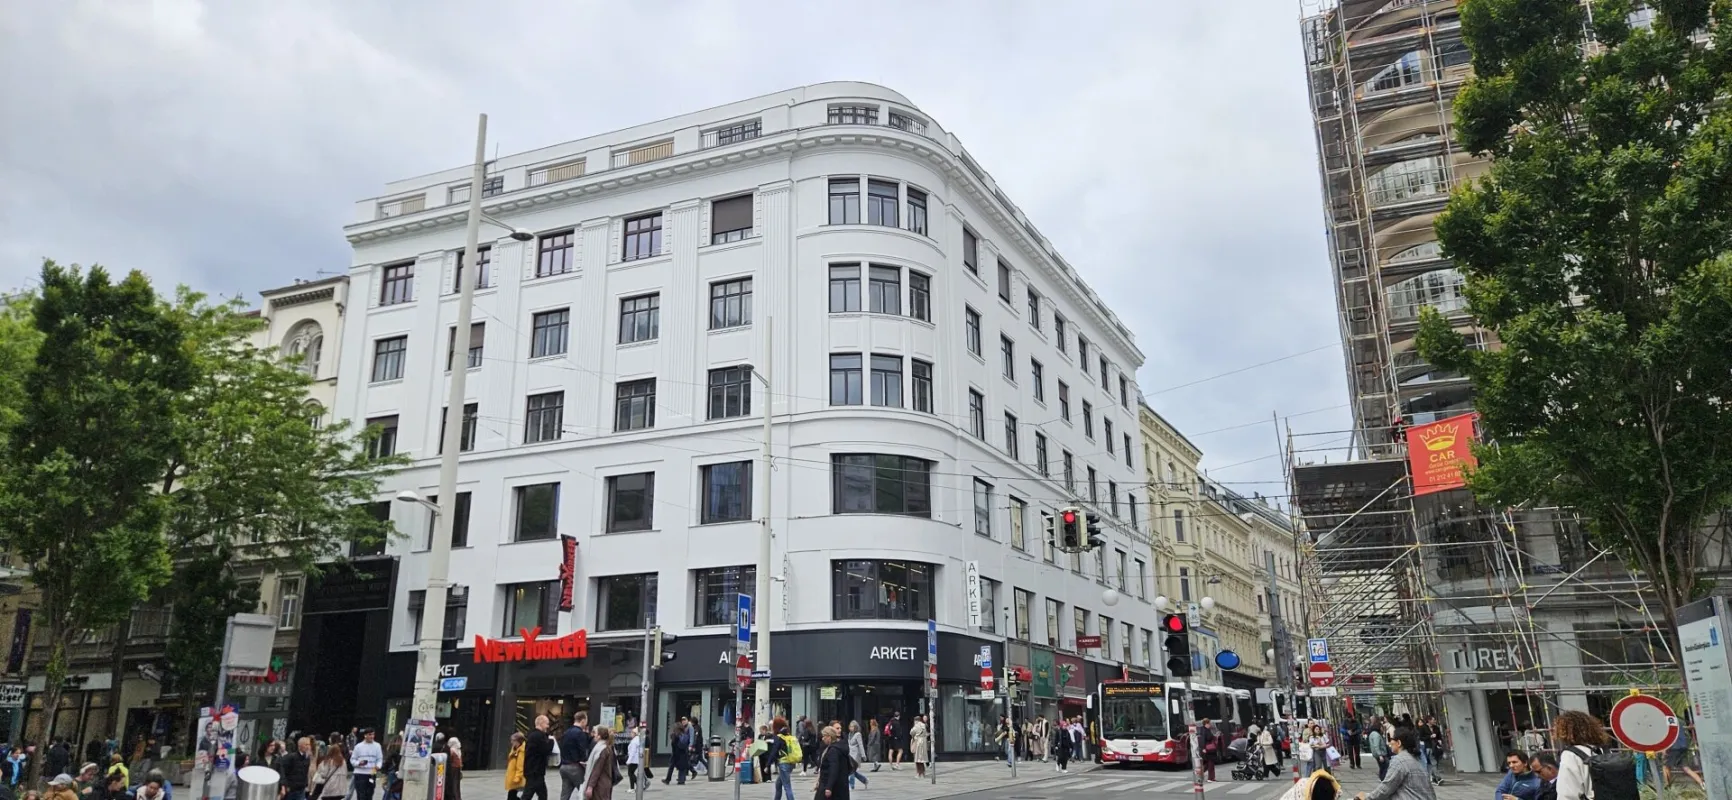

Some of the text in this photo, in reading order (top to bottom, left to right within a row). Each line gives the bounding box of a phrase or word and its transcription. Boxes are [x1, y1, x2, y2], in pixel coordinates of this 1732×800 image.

[1430, 451, 1455, 462] CAR
[968, 562, 979, 625] ARKET
[870, 646, 917, 660] ARKET
[440, 664, 460, 677] KET
[237, 685, 287, 694] POTHEKE
